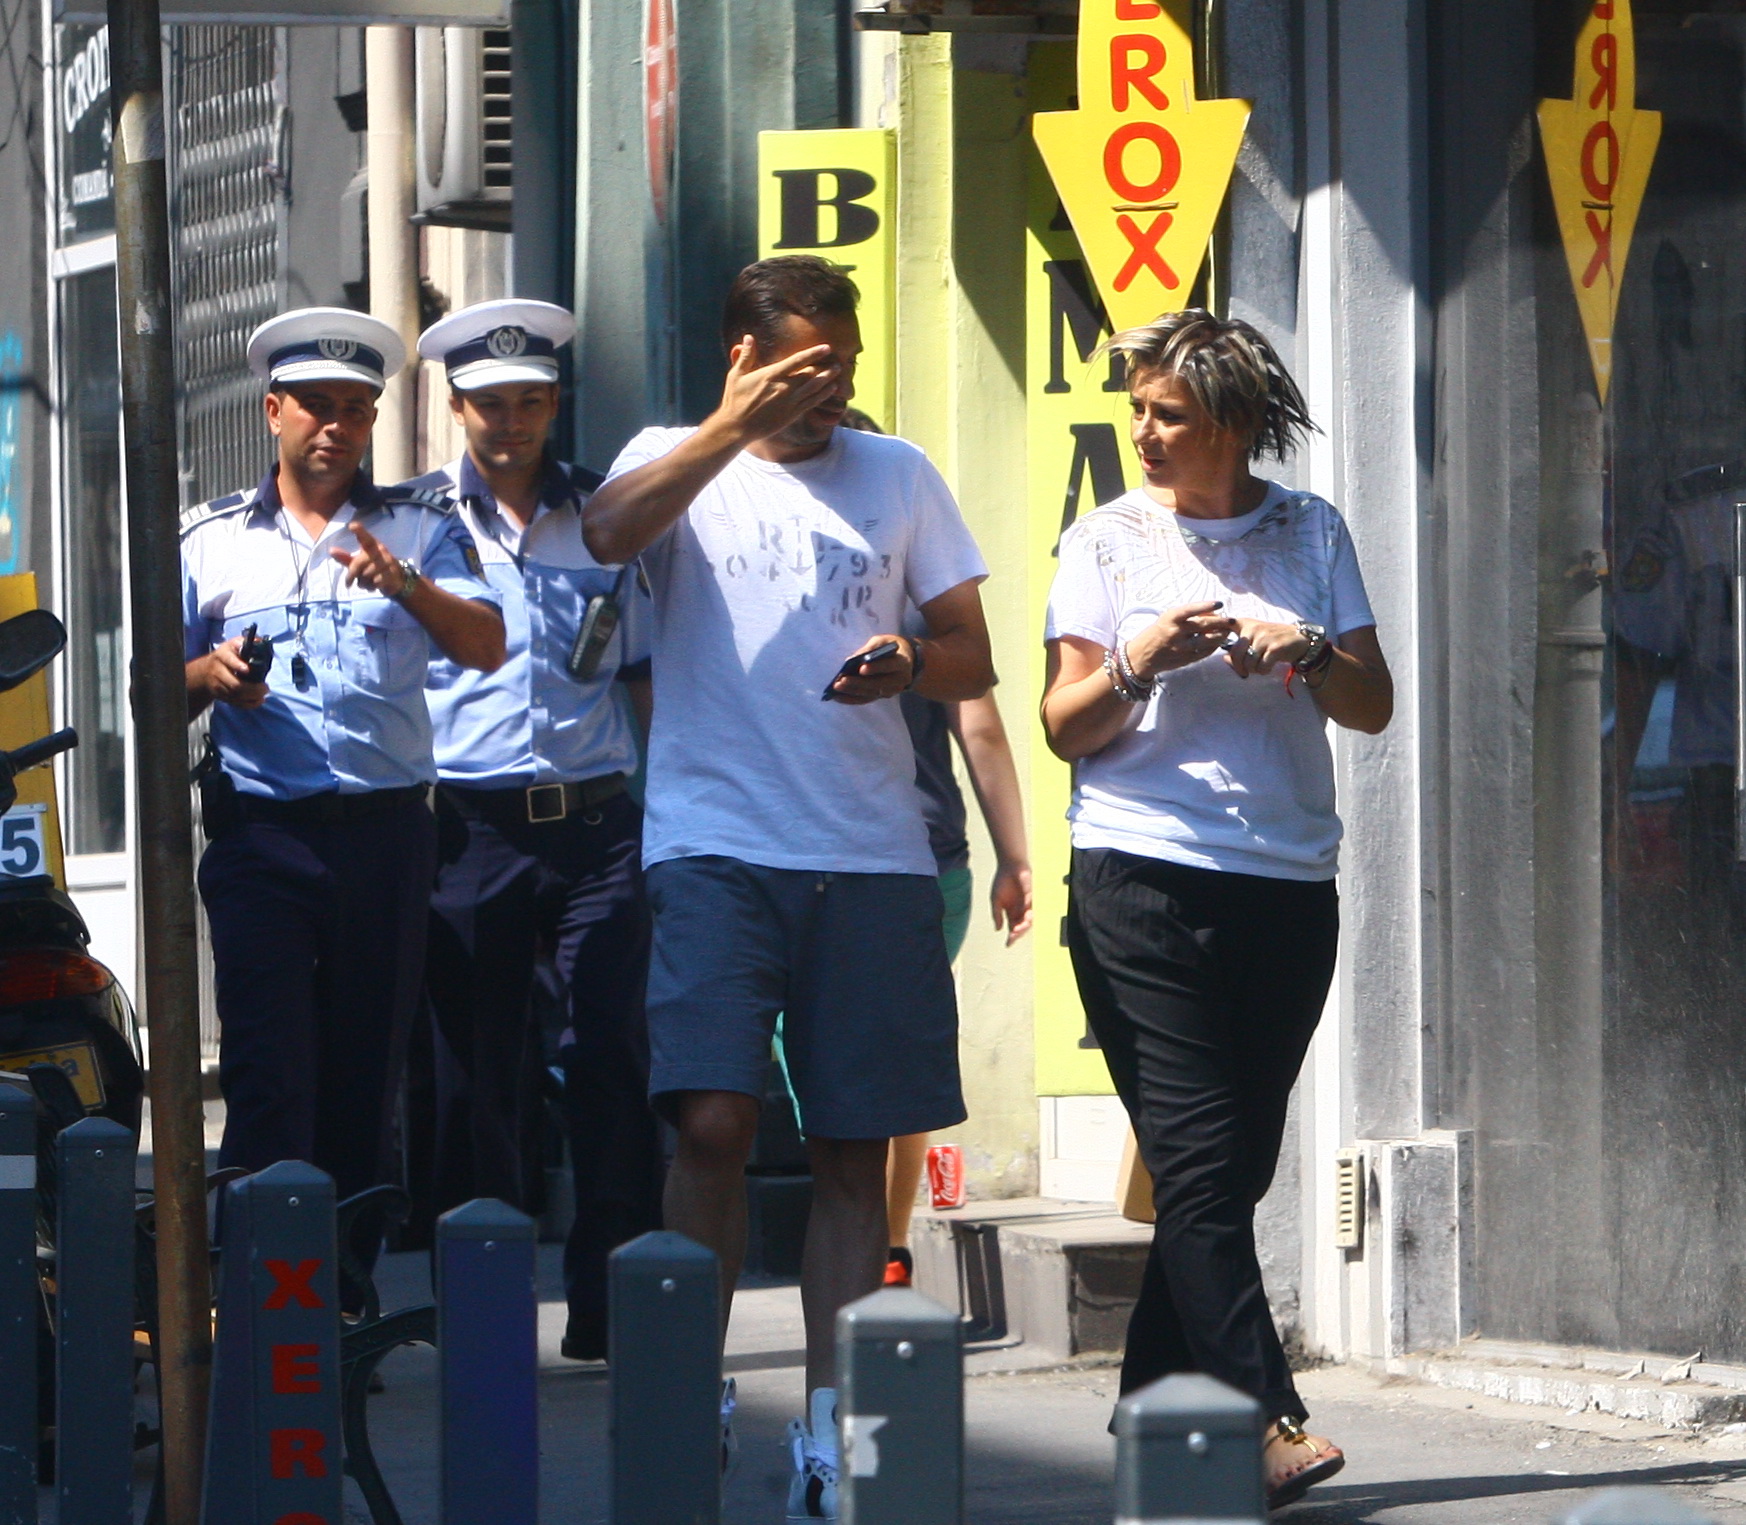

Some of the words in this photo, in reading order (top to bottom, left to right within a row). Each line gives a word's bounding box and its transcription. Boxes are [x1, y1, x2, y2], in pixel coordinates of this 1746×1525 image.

[772, 168, 880, 272] B
[1103, 0, 1182, 293] ROX
[1, 817, 40, 874] 5
[262, 1258, 328, 1525] XER
